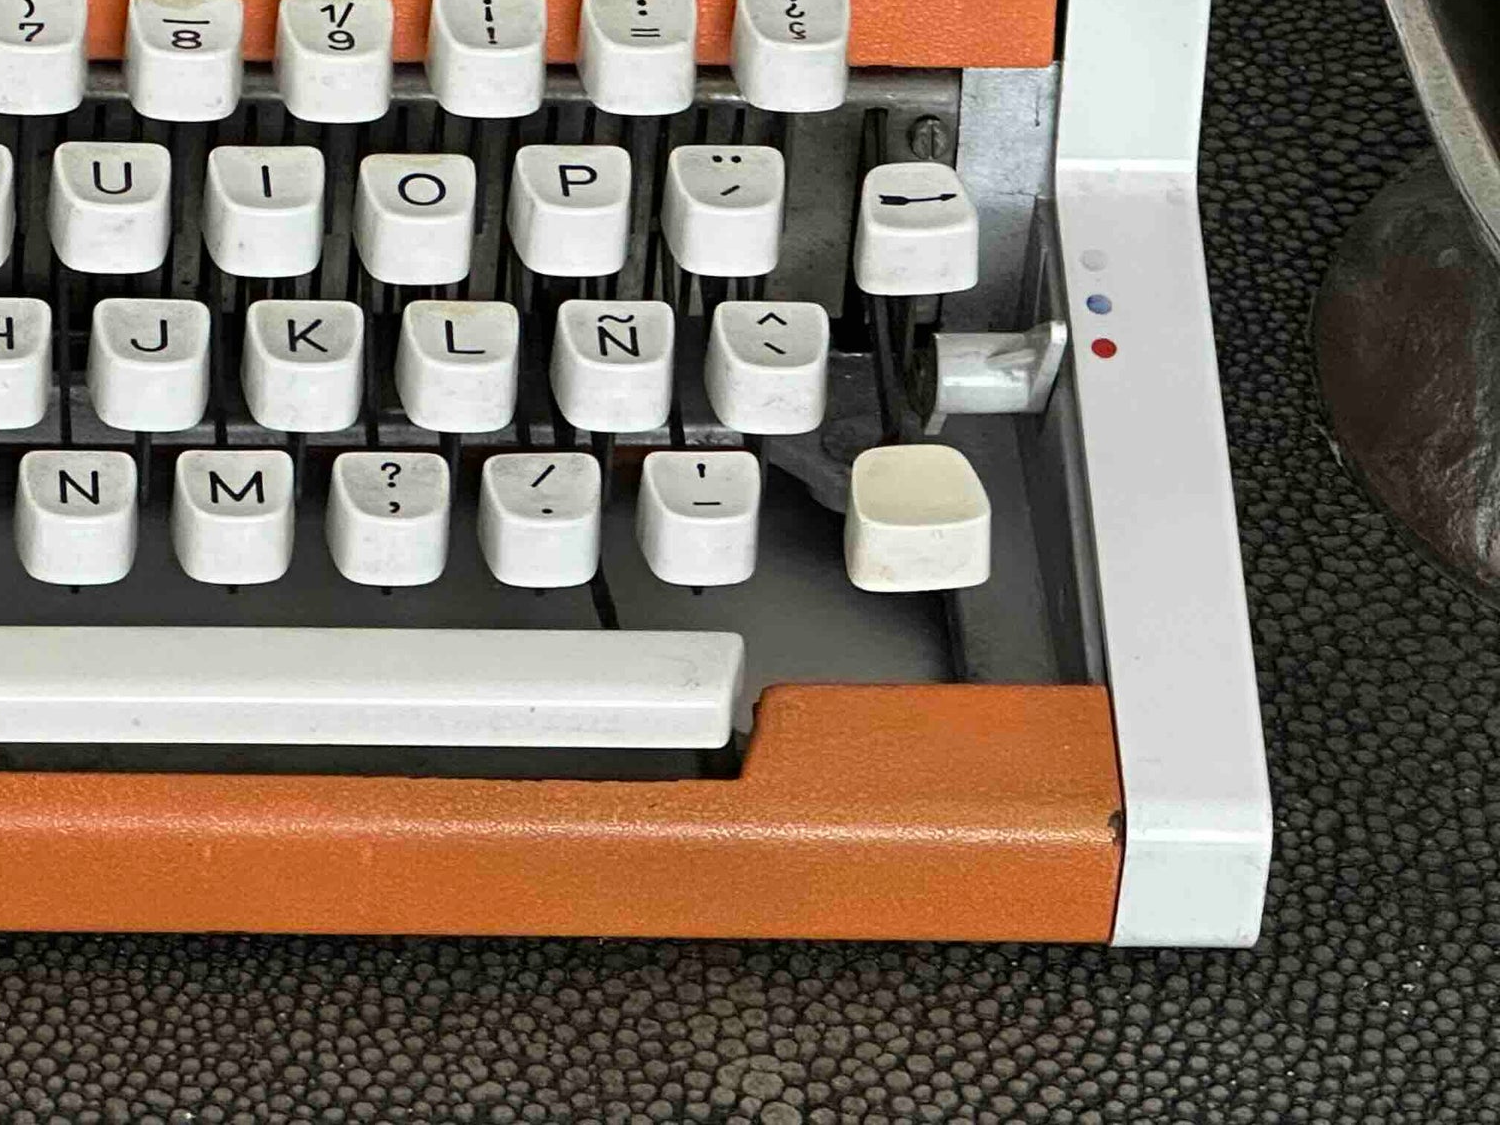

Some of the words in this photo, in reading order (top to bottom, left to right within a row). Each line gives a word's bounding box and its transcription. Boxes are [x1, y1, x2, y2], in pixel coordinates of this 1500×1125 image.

[19, 23, 44, 42] 7
[172, 30, 202, 49] 8
[328, 30, 355, 51] 9
[93, 161, 132, 194] U
[262, 165, 272, 198] I
[398, 173, 446, 206] O
[559, 165, 597, 197] P
[131, 320, 168, 352] J
[288, 319, 328, 352] K
[445, 320, 485, 354] L
[598, 315, 640, 357] Ñ
[59, 470, 99, 505] N
[209, 471, 264, 503] M
[381, 463, 401, 488] ?
